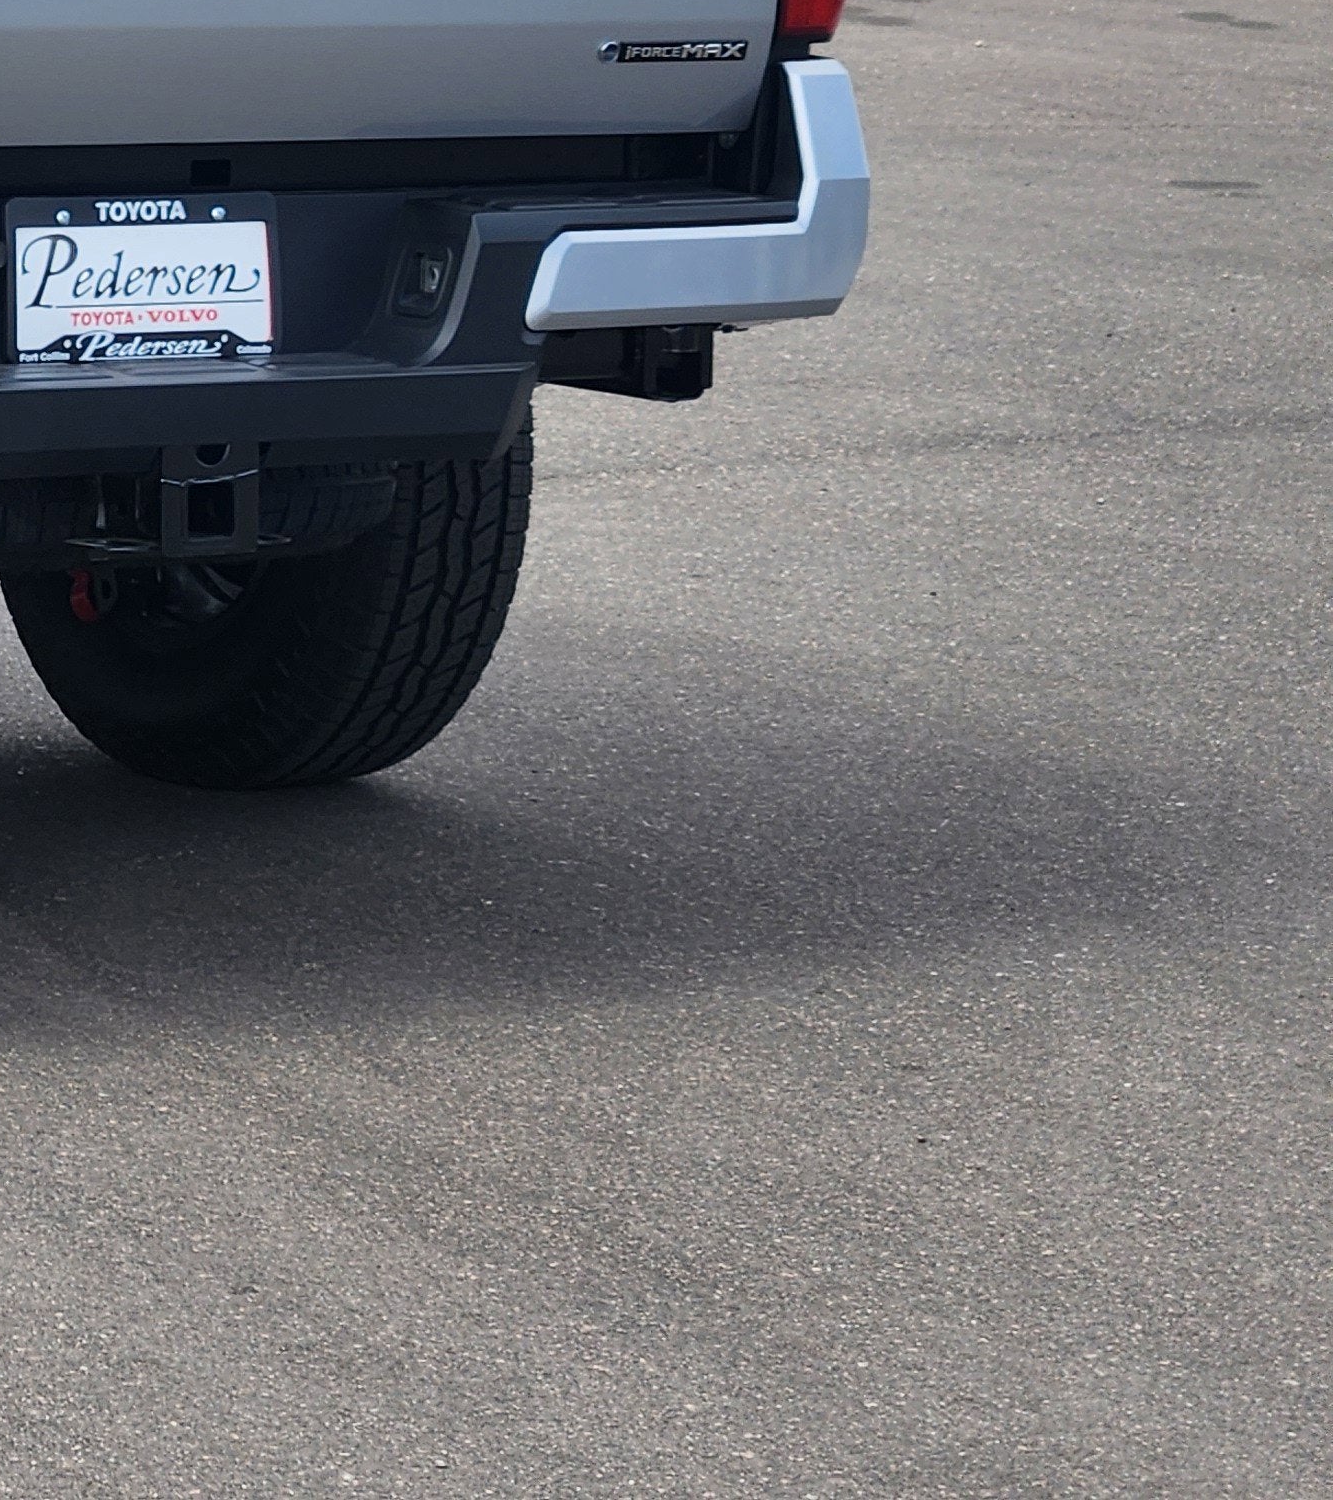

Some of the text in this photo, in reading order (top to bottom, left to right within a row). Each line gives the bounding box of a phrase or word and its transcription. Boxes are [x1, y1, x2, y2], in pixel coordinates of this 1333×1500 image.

[95, 200, 186, 222] TOYOTA
[21, 233, 261, 309] Pedersen
[71, 308, 218, 326] TOYOTA VOLVO
[76, 330, 223, 361] Pedersen
